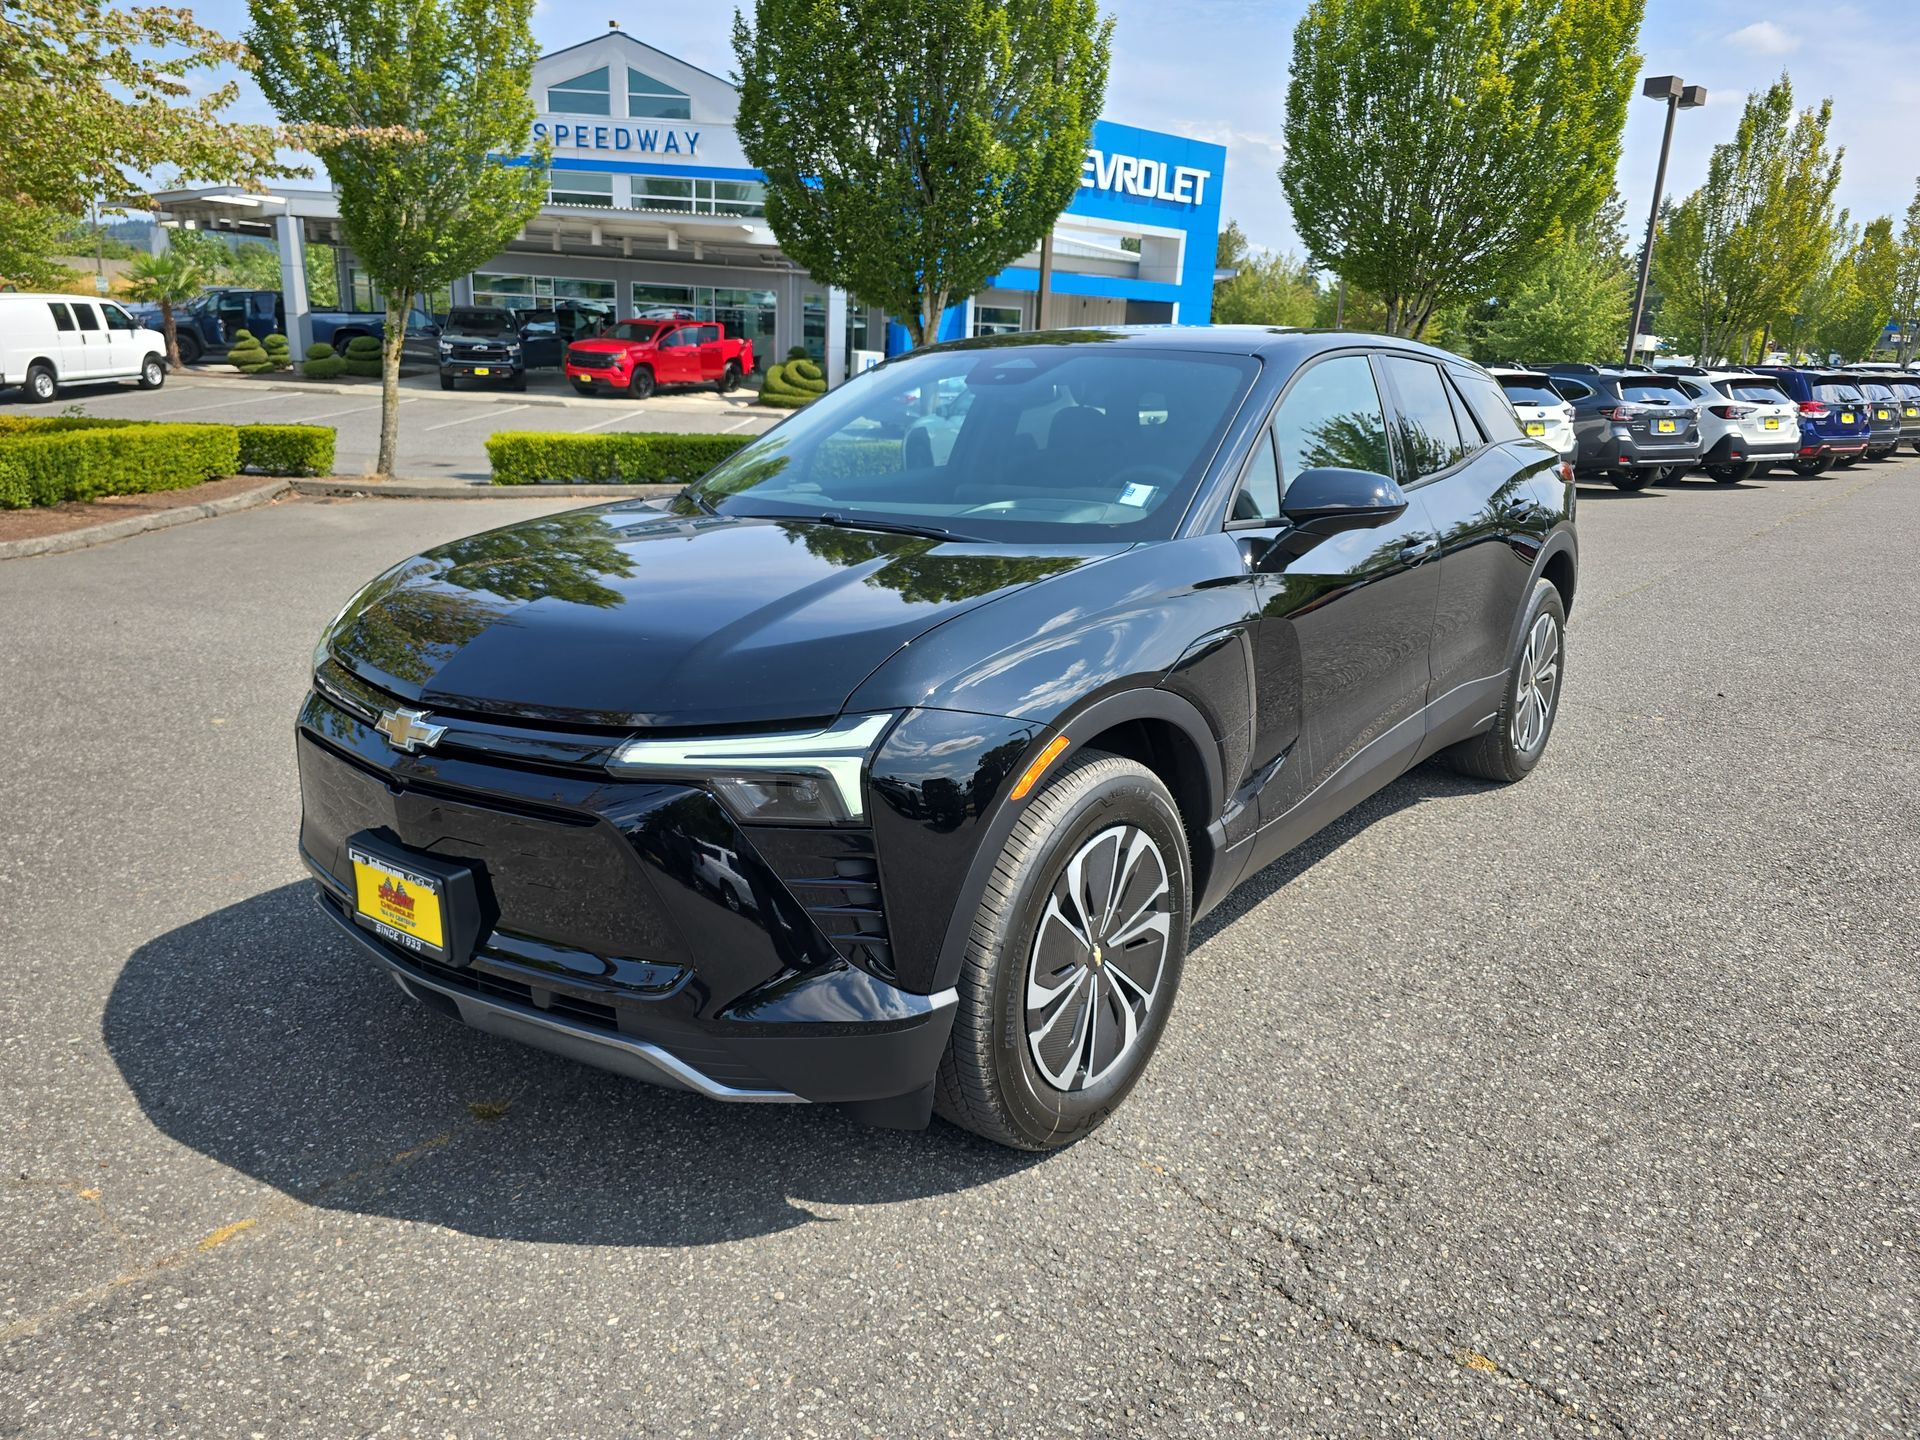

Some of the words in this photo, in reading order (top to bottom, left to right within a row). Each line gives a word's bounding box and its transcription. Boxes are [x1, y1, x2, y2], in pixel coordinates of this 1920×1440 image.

[533, 123, 700, 154] SPEEDWAY
[1080, 149, 1211, 205] EVROLET
[376, 923, 399, 941] SINCE
[401, 934, 421, 951] 1933
